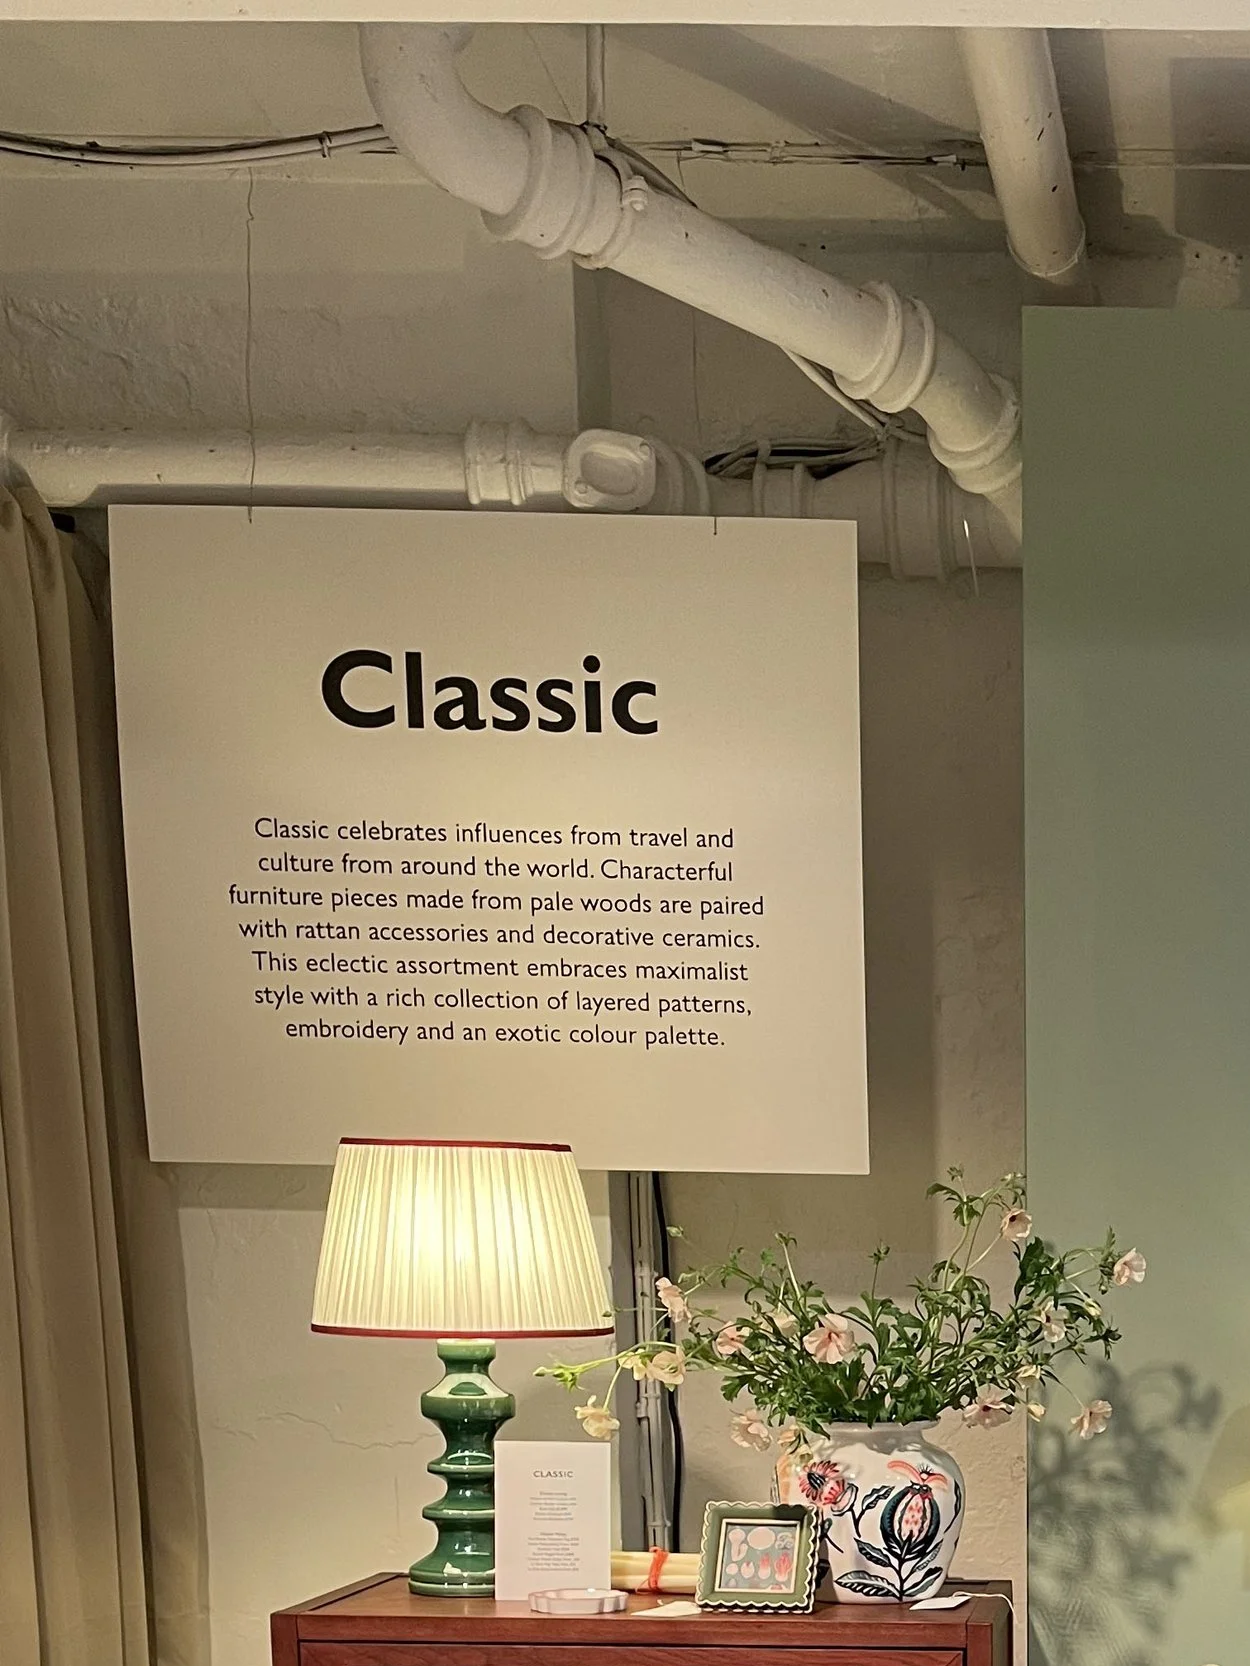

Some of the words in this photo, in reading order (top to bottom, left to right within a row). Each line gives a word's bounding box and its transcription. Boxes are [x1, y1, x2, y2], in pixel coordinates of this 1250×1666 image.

[321, 649, 659, 735] Classic
[254, 817, 330, 840] Classic
[337, 819, 448, 842] celebrates
[455, 822, 563, 845] influences
[570, 824, 621, 846] from
[628, 826, 688, 848] travel
[696, 827, 734, 849] and
[258, 851, 334, 873] culture
[341, 852, 393, 875] from
[400, 855, 476, 876] around
[484, 856, 521, 877] the
[526, 857, 595, 879] world.
[600, 858, 733, 882] Characterful
[228, 883, 324, 906] furniture
[331, 887, 398, 913] pieces
[406, 888, 464, 909] made
[471, 888, 522, 911] from
[530, 890, 574, 917] pale
[579, 892, 652, 914] woods
[659, 899, 692, 914] are
[700, 895, 764, 921] paired
[238, 917, 287, 939] with
[295, 921, 360, 940] rattan
[368, 923, 489, 943] accessories
[496, 923, 535, 944] and
[543, 923, 654, 947] decorative
[662, 929, 760, 949] ceramics.
[251, 950, 298, 972] This
[306, 952, 389, 974] eclectic
[396, 957, 520, 977] assortment
[527, 957, 628, 979] embraces
[635, 960, 749, 981] maximalist
[254, 984, 305, 1011] style
[309, 985, 359, 1006] with
[366, 992, 379, 1007] a
[386, 987, 426, 1008] rich
[433, 987, 539, 1010] collection
[547, 990, 570, 1010] of
[576, 990, 650, 1017] layered
[658, 995, 752, 1019] patterns,
[285, 1017, 409, 1046] embroidery
[416, 1020, 455, 1040] and
[462, 1027, 487, 1042] an
[495, 1023, 562, 1043] exotic
[569, 1023, 638, 1044] colour
[645, 1024, 725, 1051] palette.
[533, 1470, 574, 1478] CLASSIC
